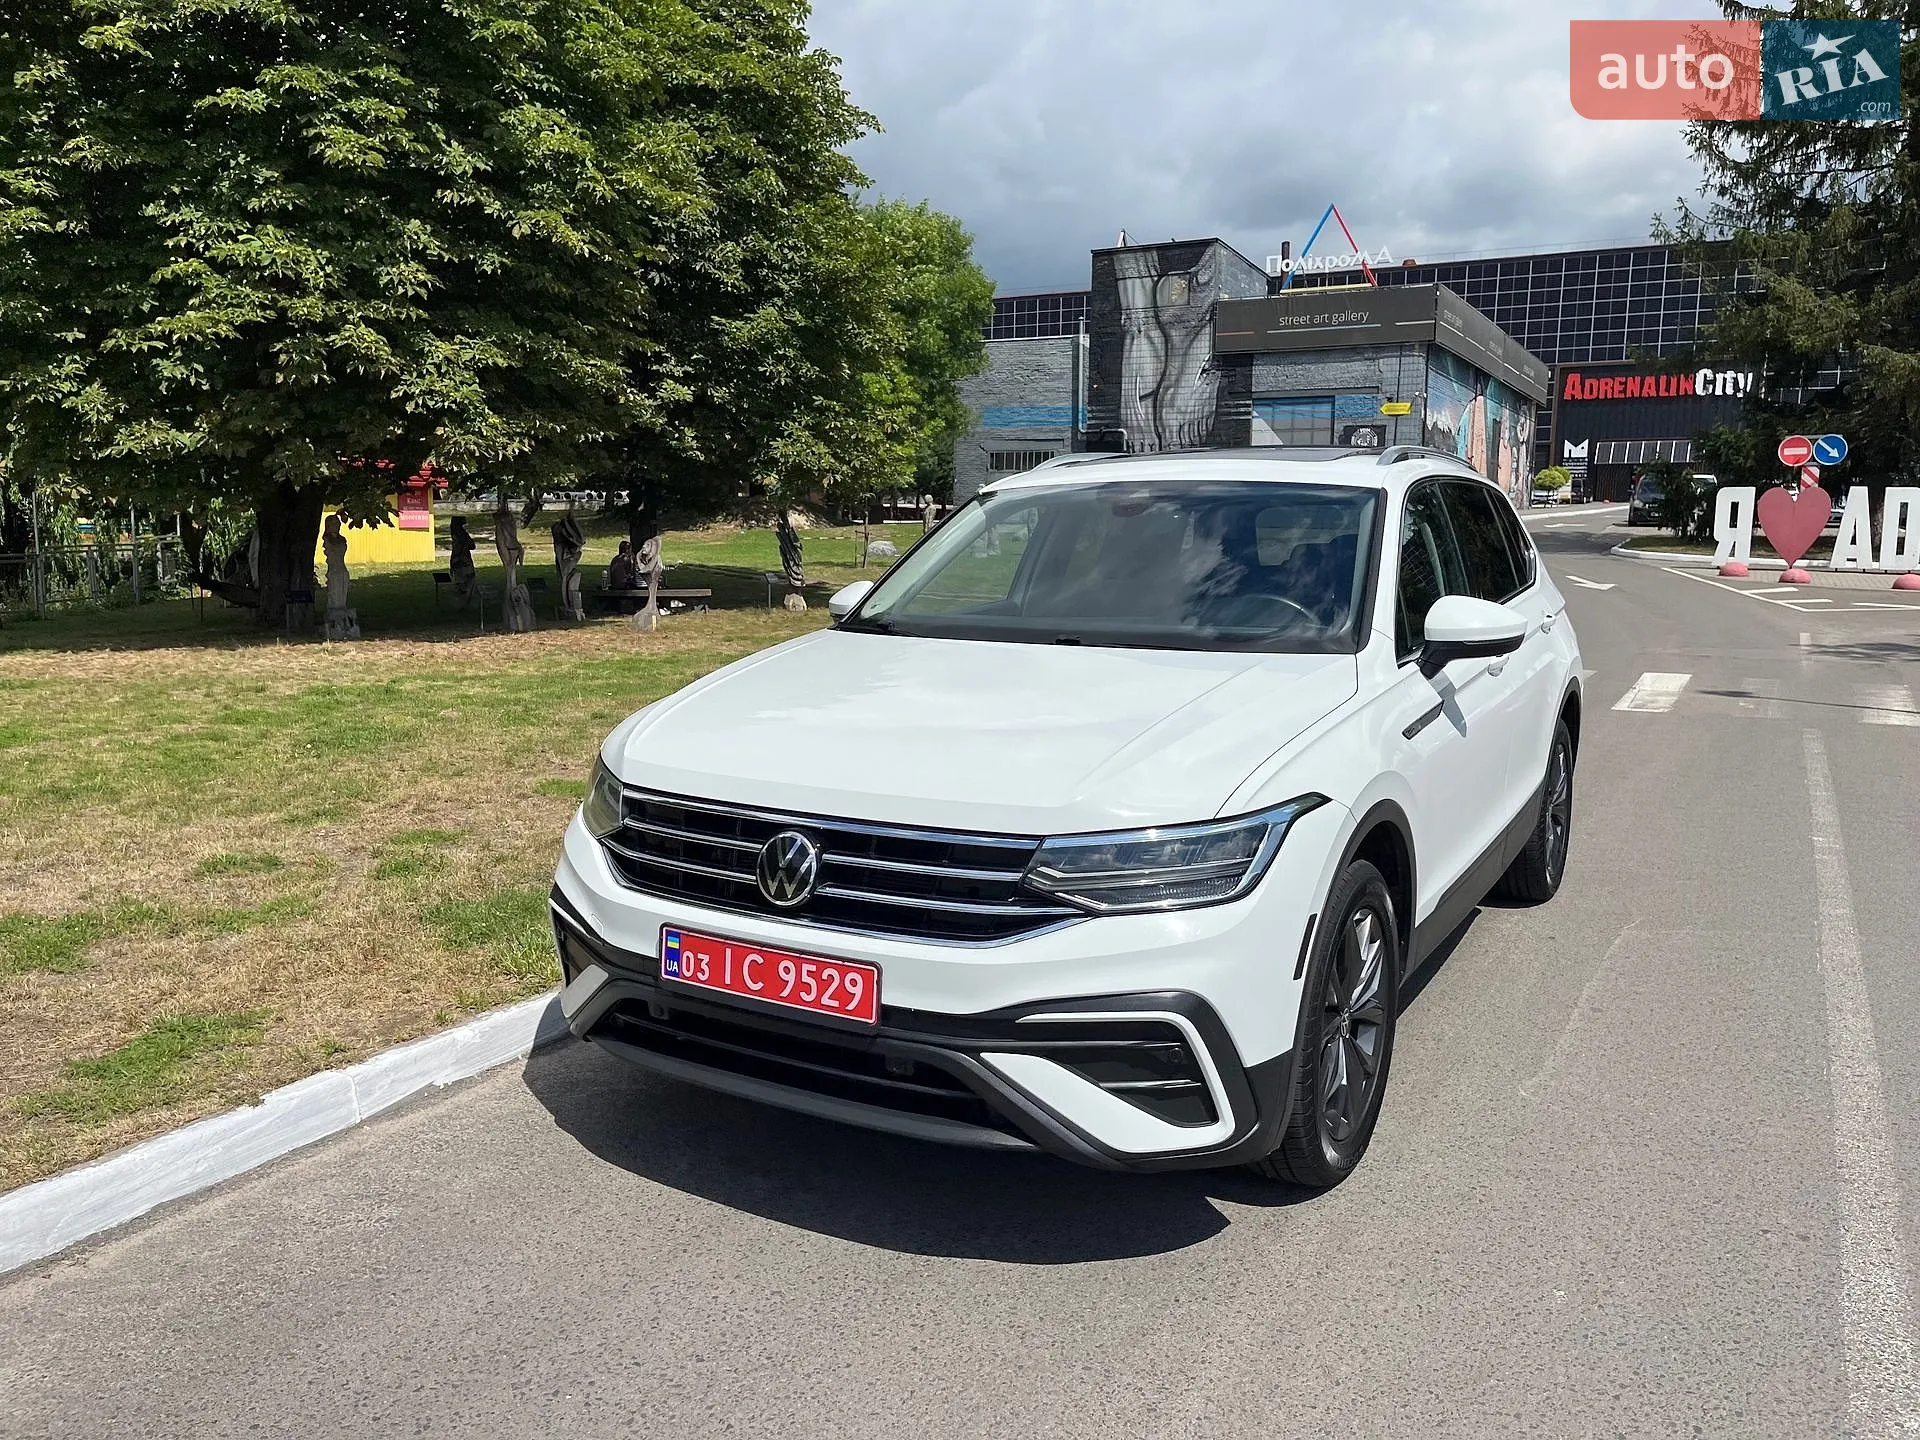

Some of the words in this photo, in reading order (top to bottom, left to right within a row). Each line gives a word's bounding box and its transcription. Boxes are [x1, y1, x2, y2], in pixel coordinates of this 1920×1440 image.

[1279, 315, 1310, 326] street
[1313, 313, 1329, 324] art
[1332, 310, 1369, 325] gallery
[666, 959, 679, 973] UA
[681, 950, 710, 981] 03
[777, 960, 864, 1010] 9529
